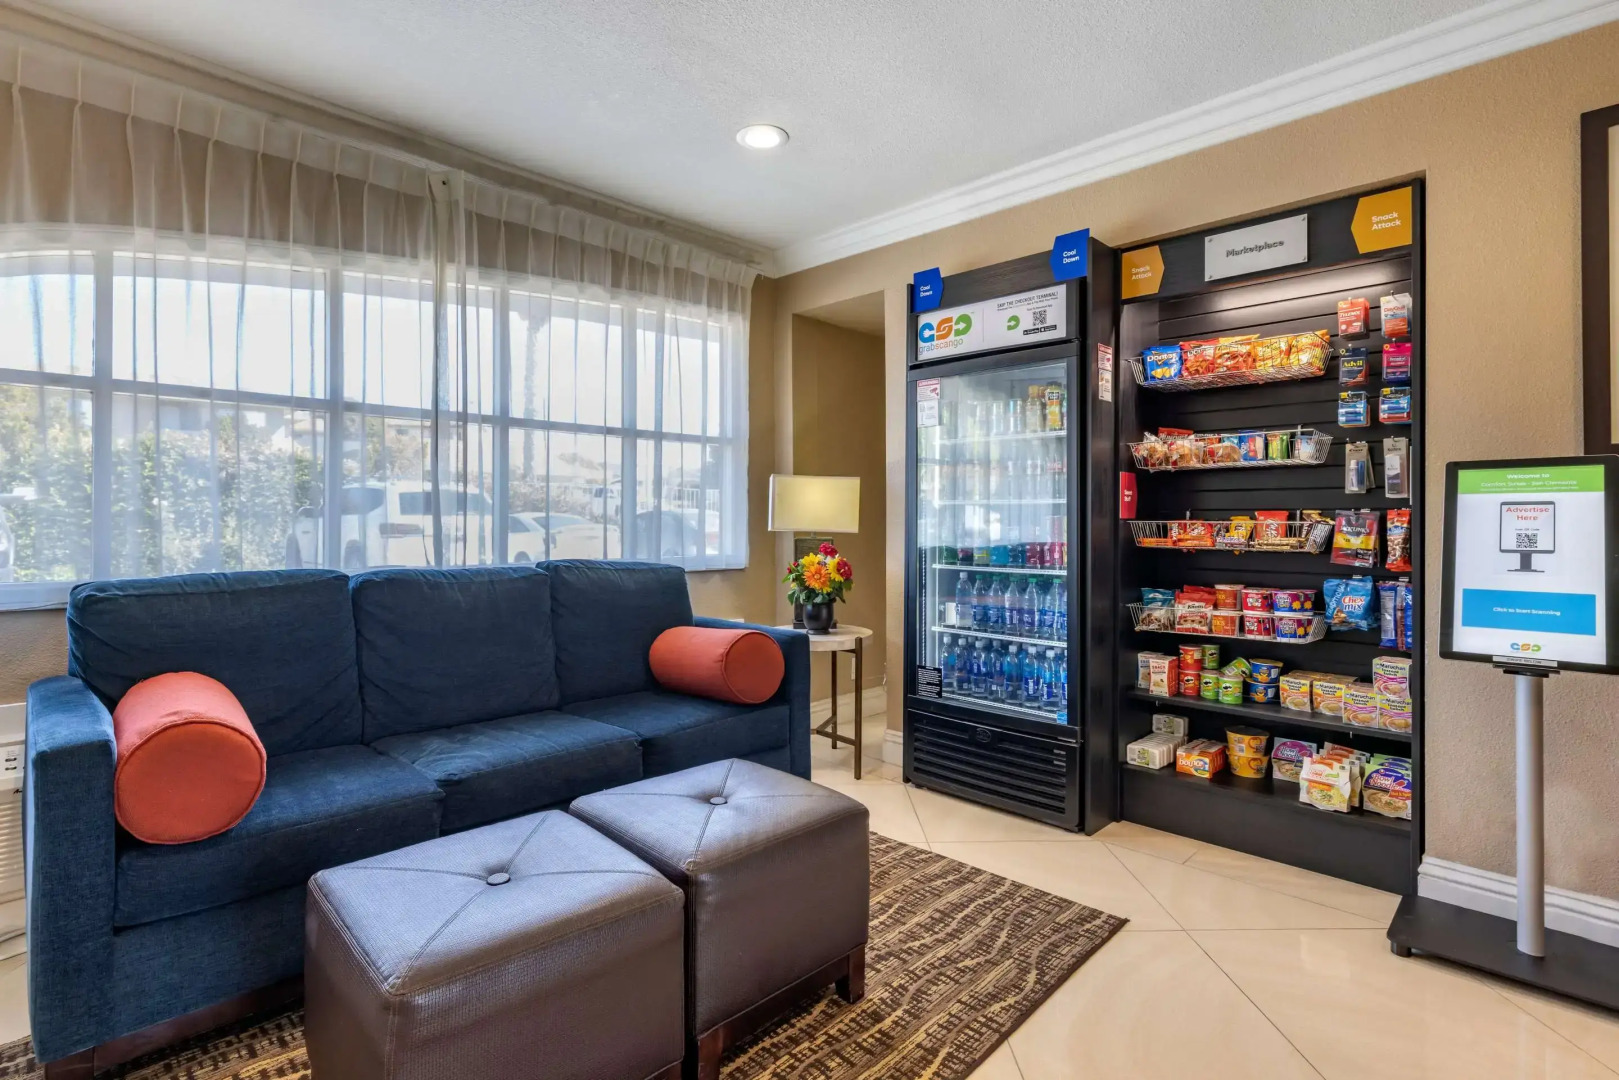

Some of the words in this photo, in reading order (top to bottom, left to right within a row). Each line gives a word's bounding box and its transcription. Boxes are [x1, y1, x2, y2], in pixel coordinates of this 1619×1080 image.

[1371, 211, 1399, 223] Snack
[1371, 219, 1401, 231] Attack
[1063, 249, 1077, 257] Cool
[1226, 239, 1285, 258] Marketplace
[1063, 256, 1080, 264] Down
[1131, 265, 1151, 274] Snack
[1131, 272, 1152, 281] Attack
[919, 338, 964, 355] grabscango
[1342, 596, 1365, 604] Chex
[1344, 604, 1363, 612] mix
[1380, 664, 1406, 672] Maruchan
[1285, 679, 1308, 687] Maruchan
[1319, 684, 1344, 692] Maruchan
[1350, 692, 1376, 701] Maruchan
[1371, 773, 1395, 784] Bowl
[1370, 778, 1401, 790] Noodle
